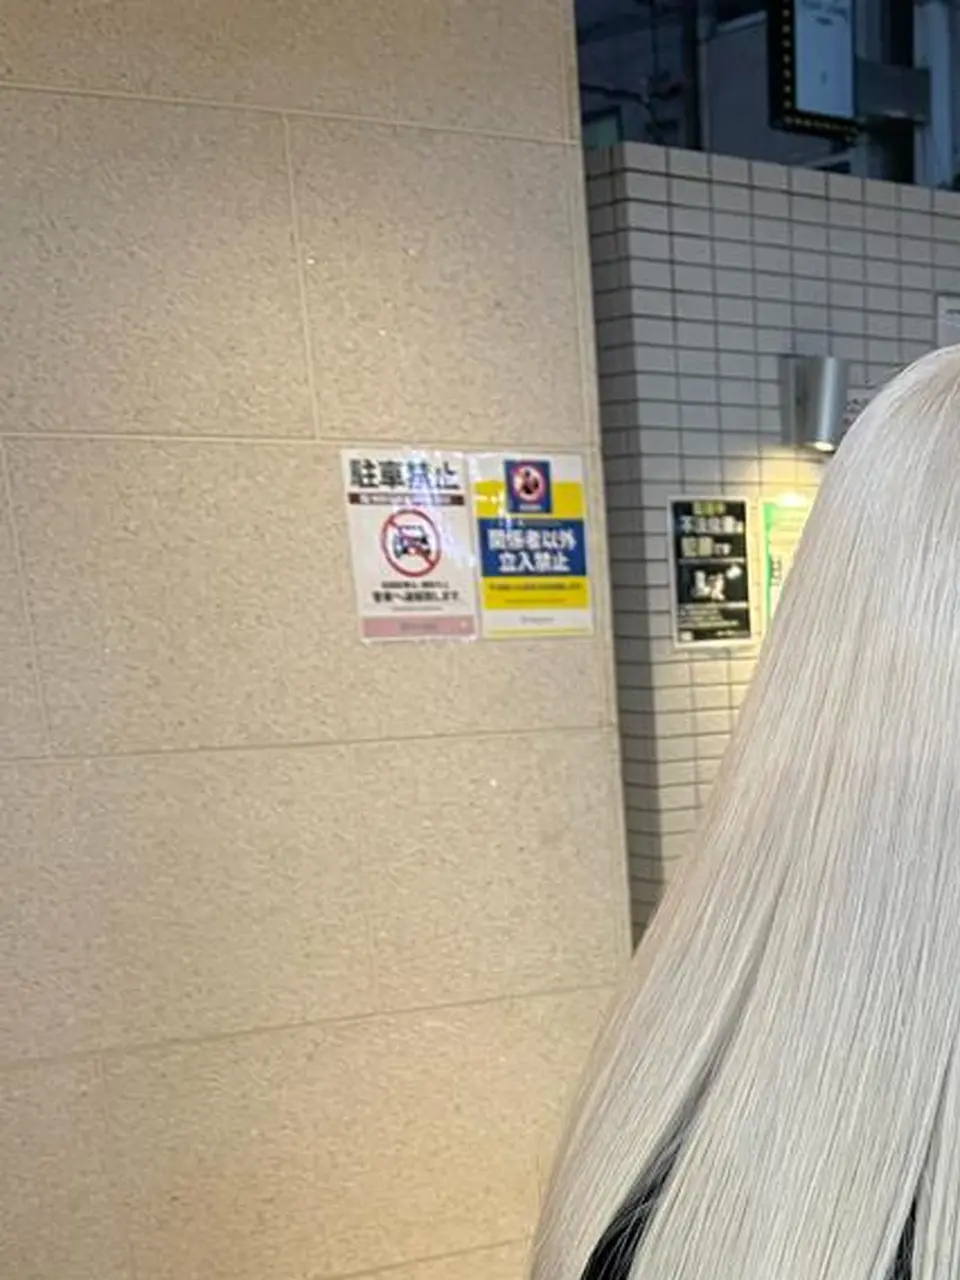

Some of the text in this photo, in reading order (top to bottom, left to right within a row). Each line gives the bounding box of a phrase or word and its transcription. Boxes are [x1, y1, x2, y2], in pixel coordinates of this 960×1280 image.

[349, 458, 461, 488] 駐車禁止
[488, 528, 577, 551] 関係者以外
[498, 551, 571, 573] 立入禁止
